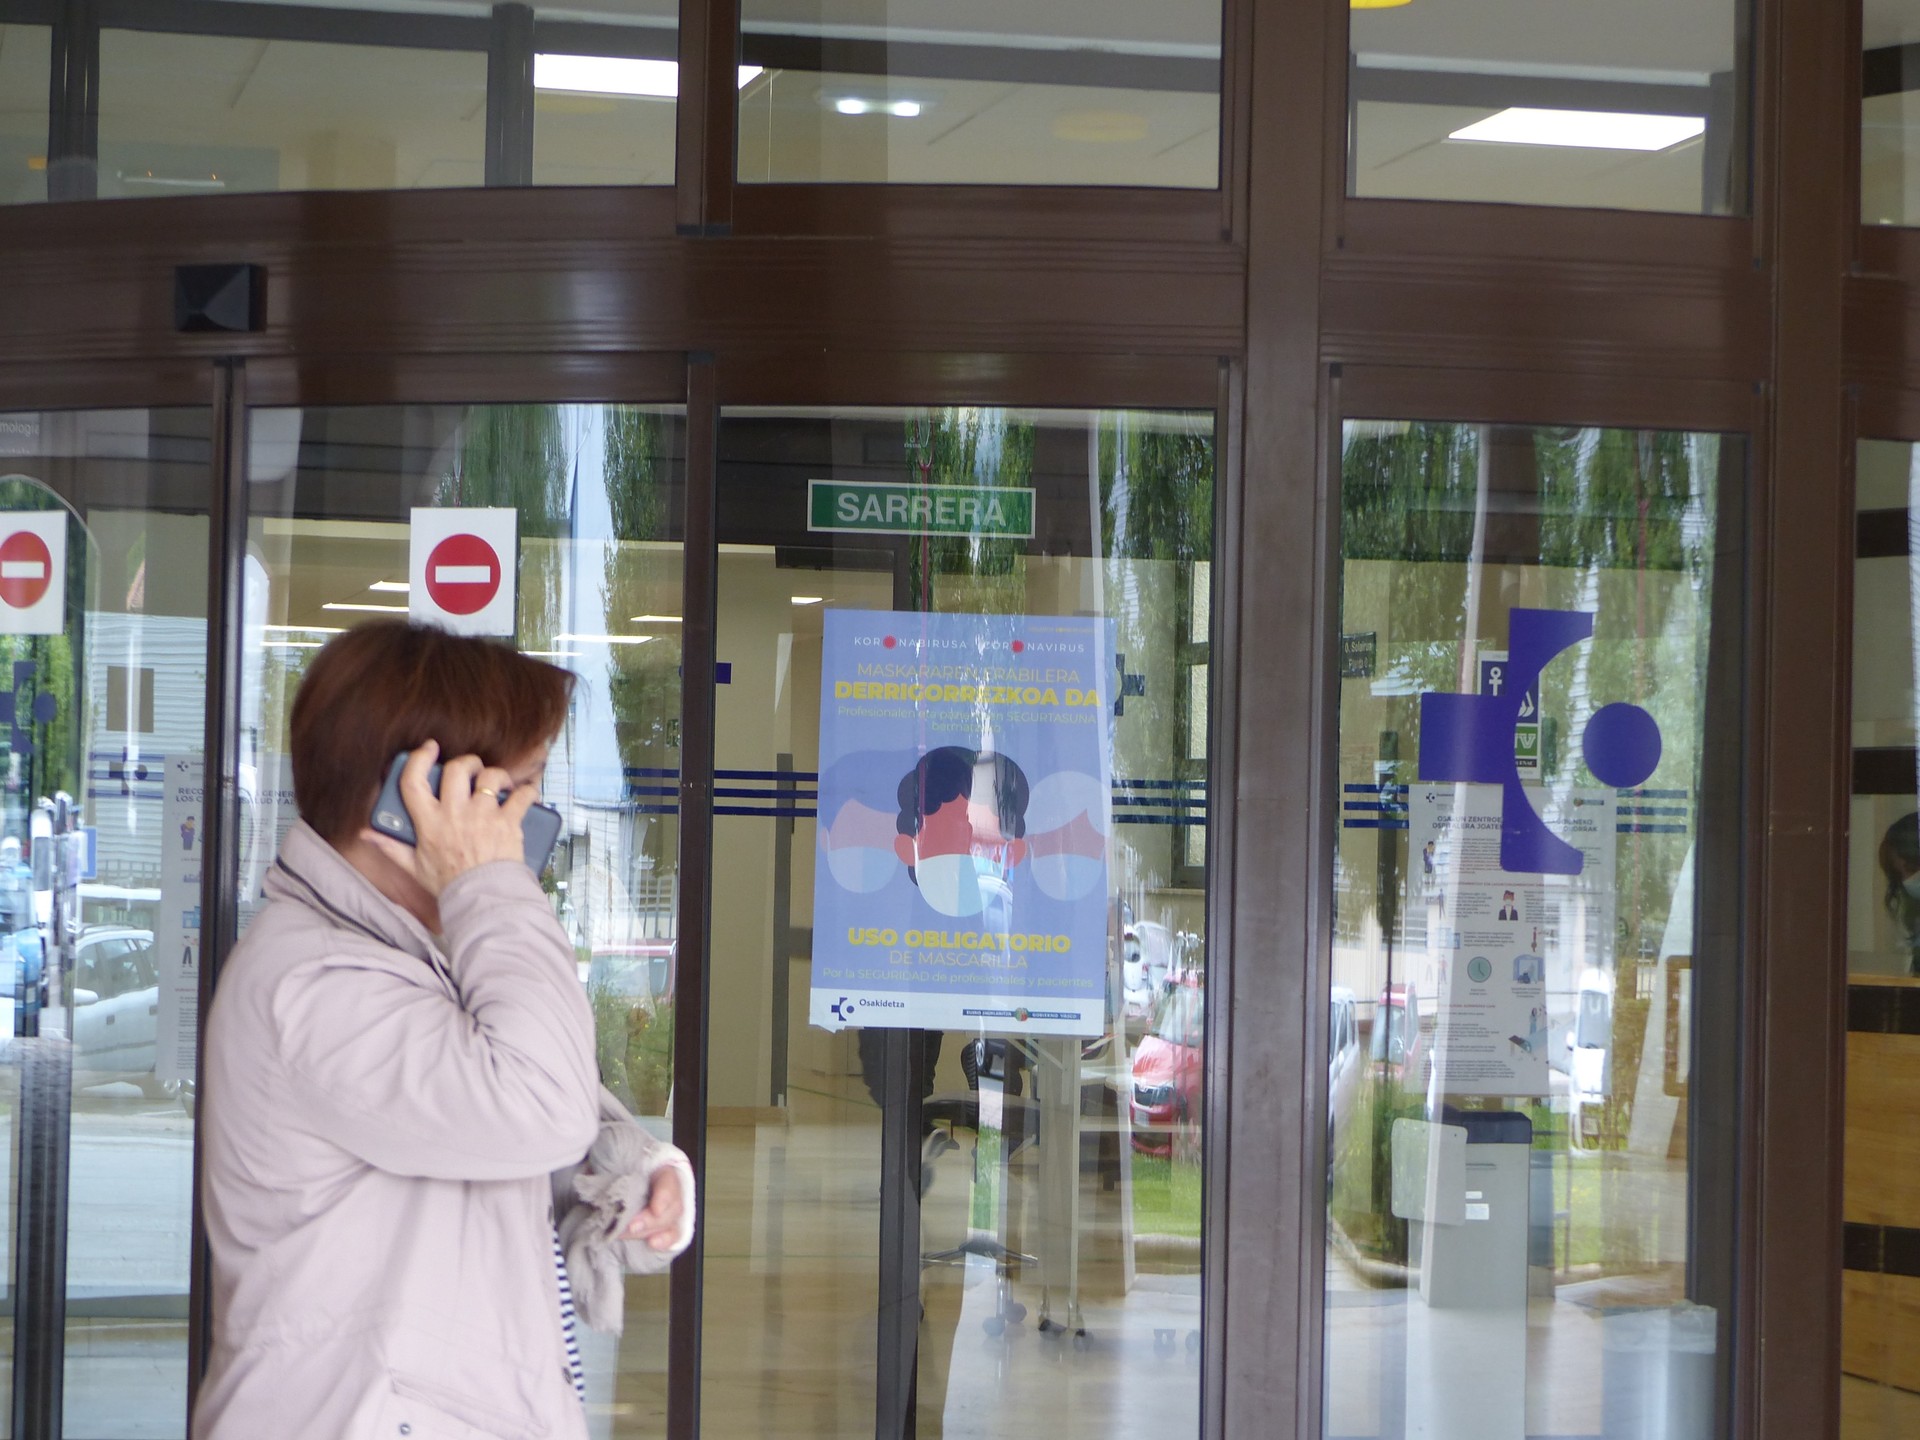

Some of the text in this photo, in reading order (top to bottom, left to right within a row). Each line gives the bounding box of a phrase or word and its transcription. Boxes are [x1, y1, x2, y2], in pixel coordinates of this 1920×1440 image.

[837, 492, 1006, 526] SARRERA
[857, 663, 1080, 683] MASKARAREN ERABILERA
[835, 681, 1101, 706] DERRIGORREZKOA DA
[838, 705, 916, 719] Profesionalen
[1007, 710, 1097, 724] SEGURTASUNA
[848, 928, 1071, 953] USO OBLIGATORIO
[889, 950, 1028, 969] DE MASCARILLA
[823, 967, 1094, 989] Por la SEGURIDAD de profesionales y pacientes
[859, 998, 905, 1009] Osakidetza
